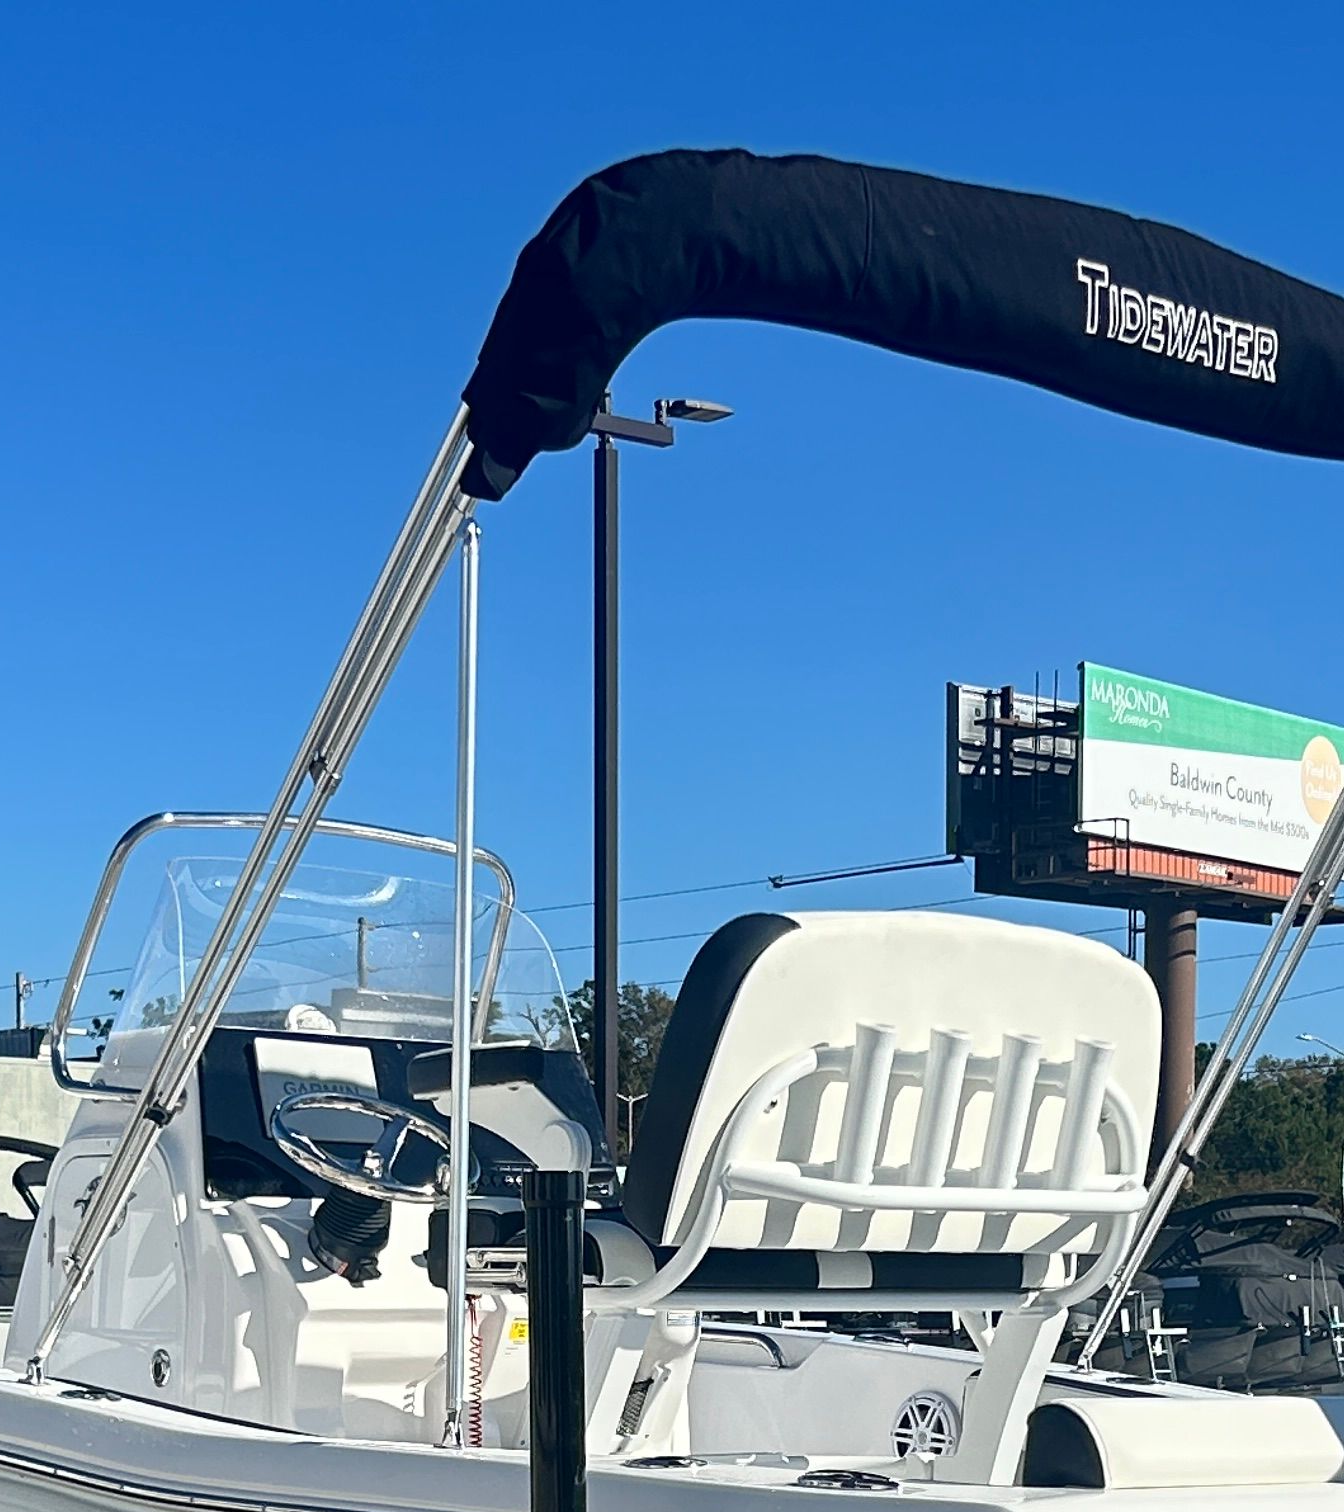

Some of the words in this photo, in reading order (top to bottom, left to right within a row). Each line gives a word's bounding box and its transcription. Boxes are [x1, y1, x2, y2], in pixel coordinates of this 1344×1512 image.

[1076, 257, 1279, 384] TIDEWATER
[1091, 677, 1171, 719] MARONDA
[1128, 788, 1158, 811] Quality
[1169, 762, 1223, 798] Baldwin
[1225, 776, 1273, 816] County
